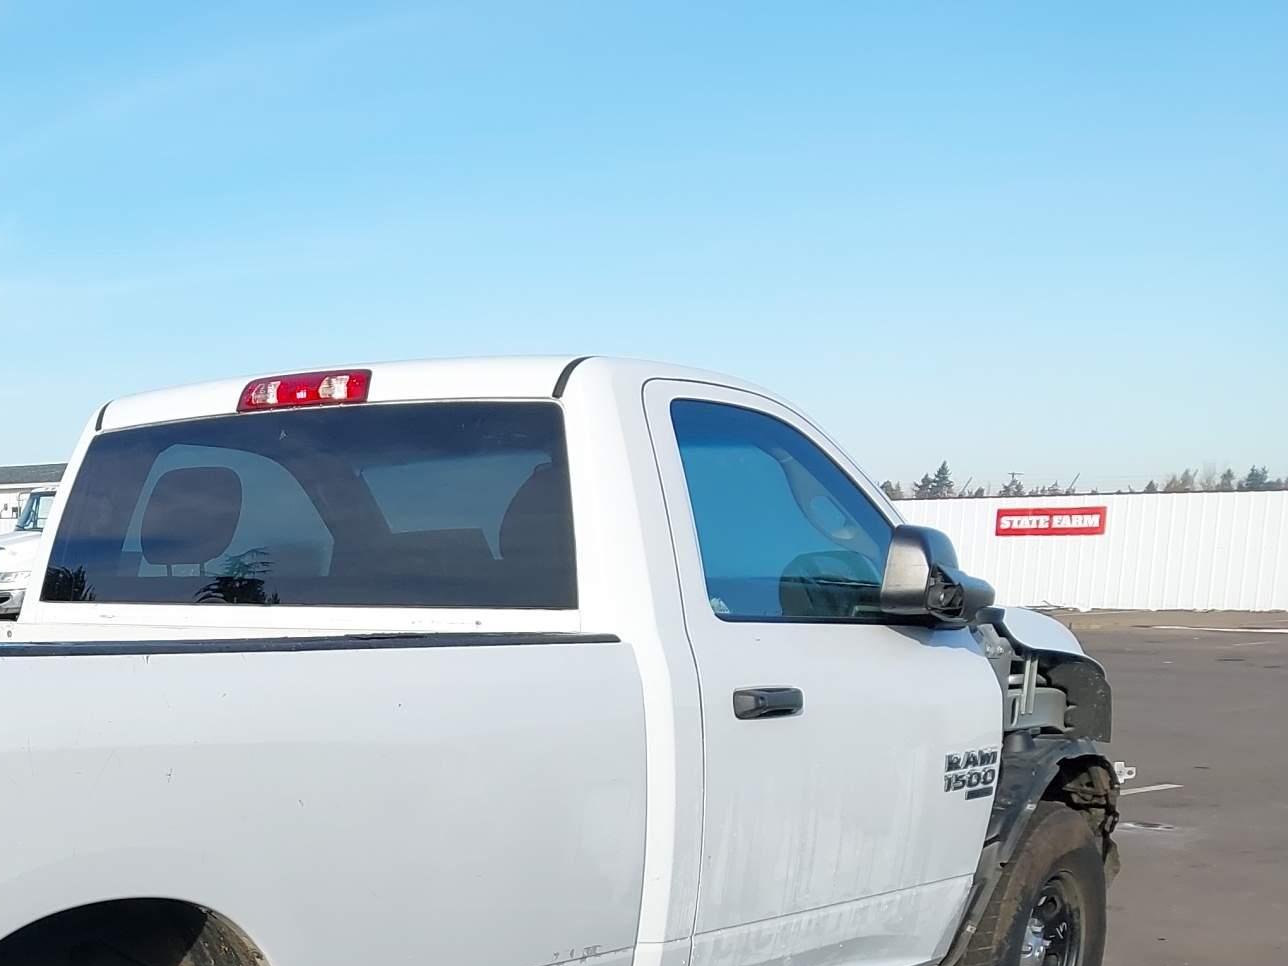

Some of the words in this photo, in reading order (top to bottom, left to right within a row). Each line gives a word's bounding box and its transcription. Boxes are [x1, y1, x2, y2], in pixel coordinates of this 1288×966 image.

[999, 515, 1050, 530] STATE
[1051, 513, 1101, 529] FARM
[944, 746, 998, 773] RAM
[943, 767, 996, 793] 1500
